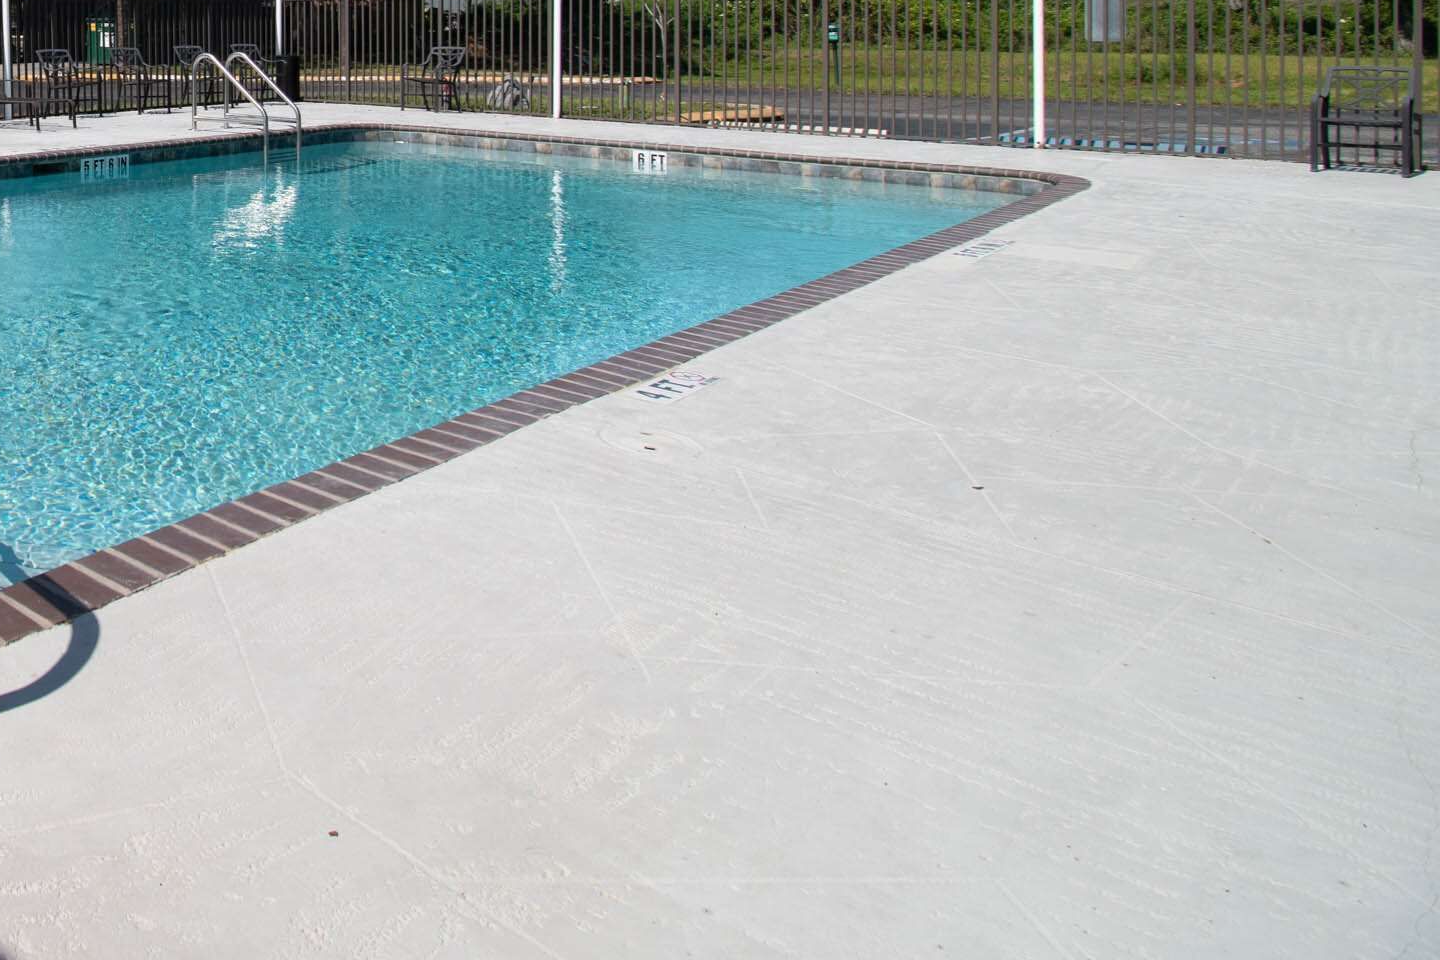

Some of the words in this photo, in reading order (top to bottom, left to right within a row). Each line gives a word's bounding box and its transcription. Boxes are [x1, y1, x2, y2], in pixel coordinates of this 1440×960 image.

[651, 154, 665, 169] FT
[649, 379, 696, 393] FT
[636, 389, 672, 399] 4
